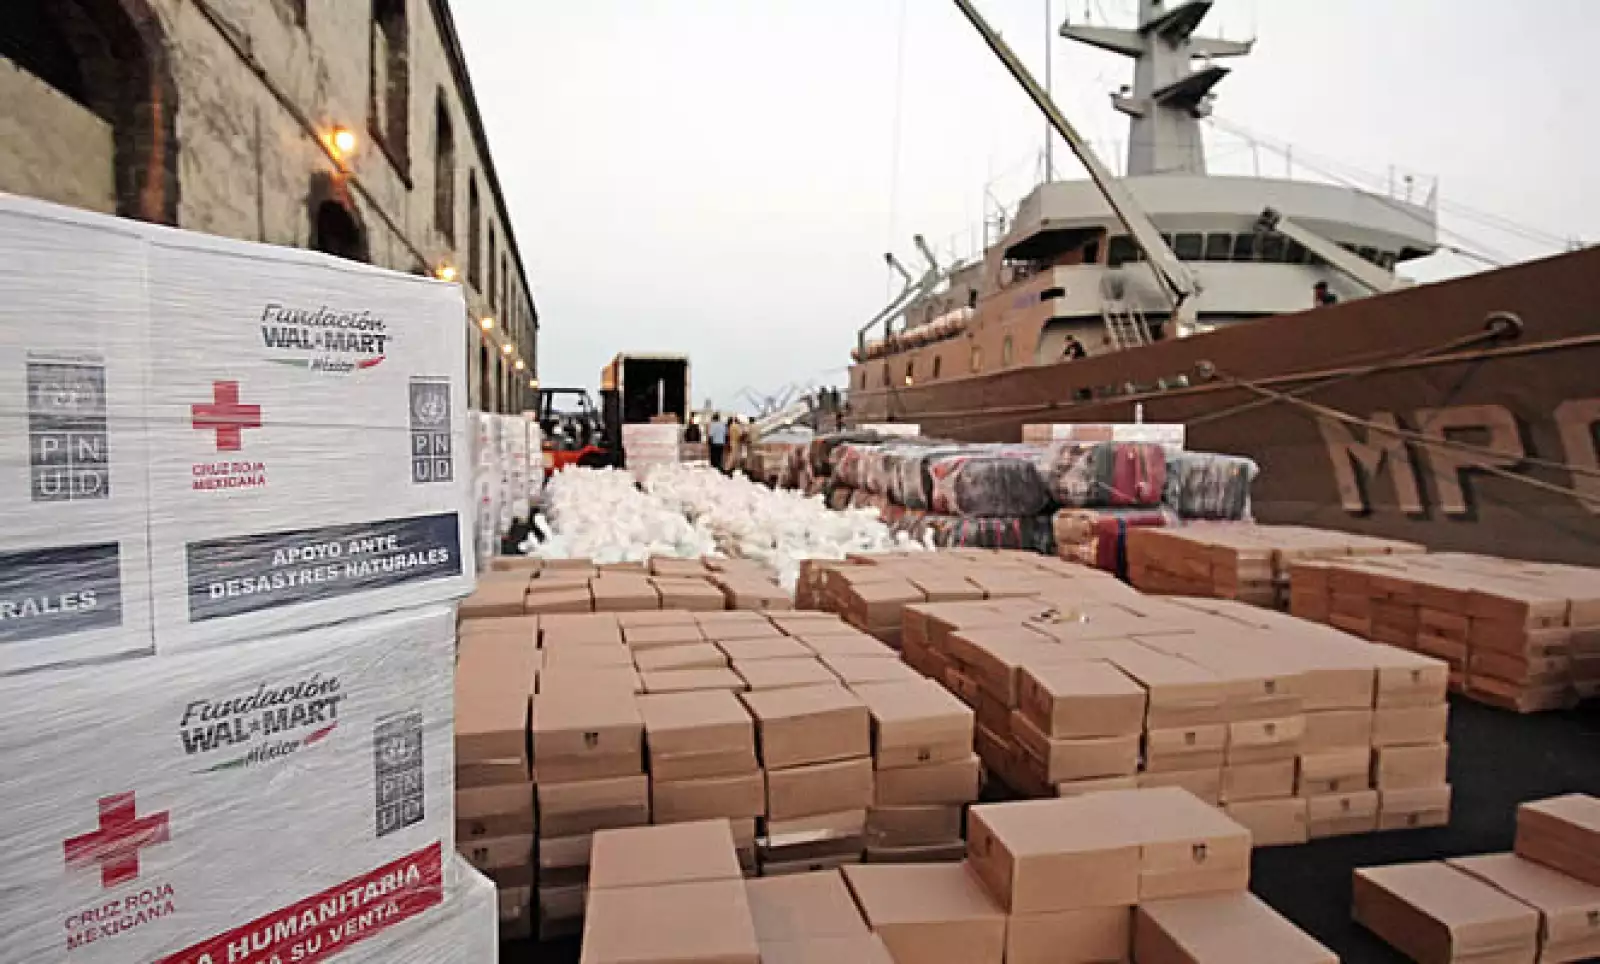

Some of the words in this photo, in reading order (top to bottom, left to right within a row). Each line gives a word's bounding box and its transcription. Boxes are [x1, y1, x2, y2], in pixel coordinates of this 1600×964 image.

[209, 565, 338, 599] DESASTRES
[346, 547, 449, 578] NATURALES
[272, 541, 342, 566] APOYO
[349, 534, 399, 554] ANTE
[65, 900, 121, 930] CRUZ
[125, 884, 174, 912] ROJA
[67, 900, 174, 951] MEXICANA
[228, 864, 421, 962] HUMANITARIA
[291, 934, 321, 960] SU
[330, 899, 400, 942] VENTA
